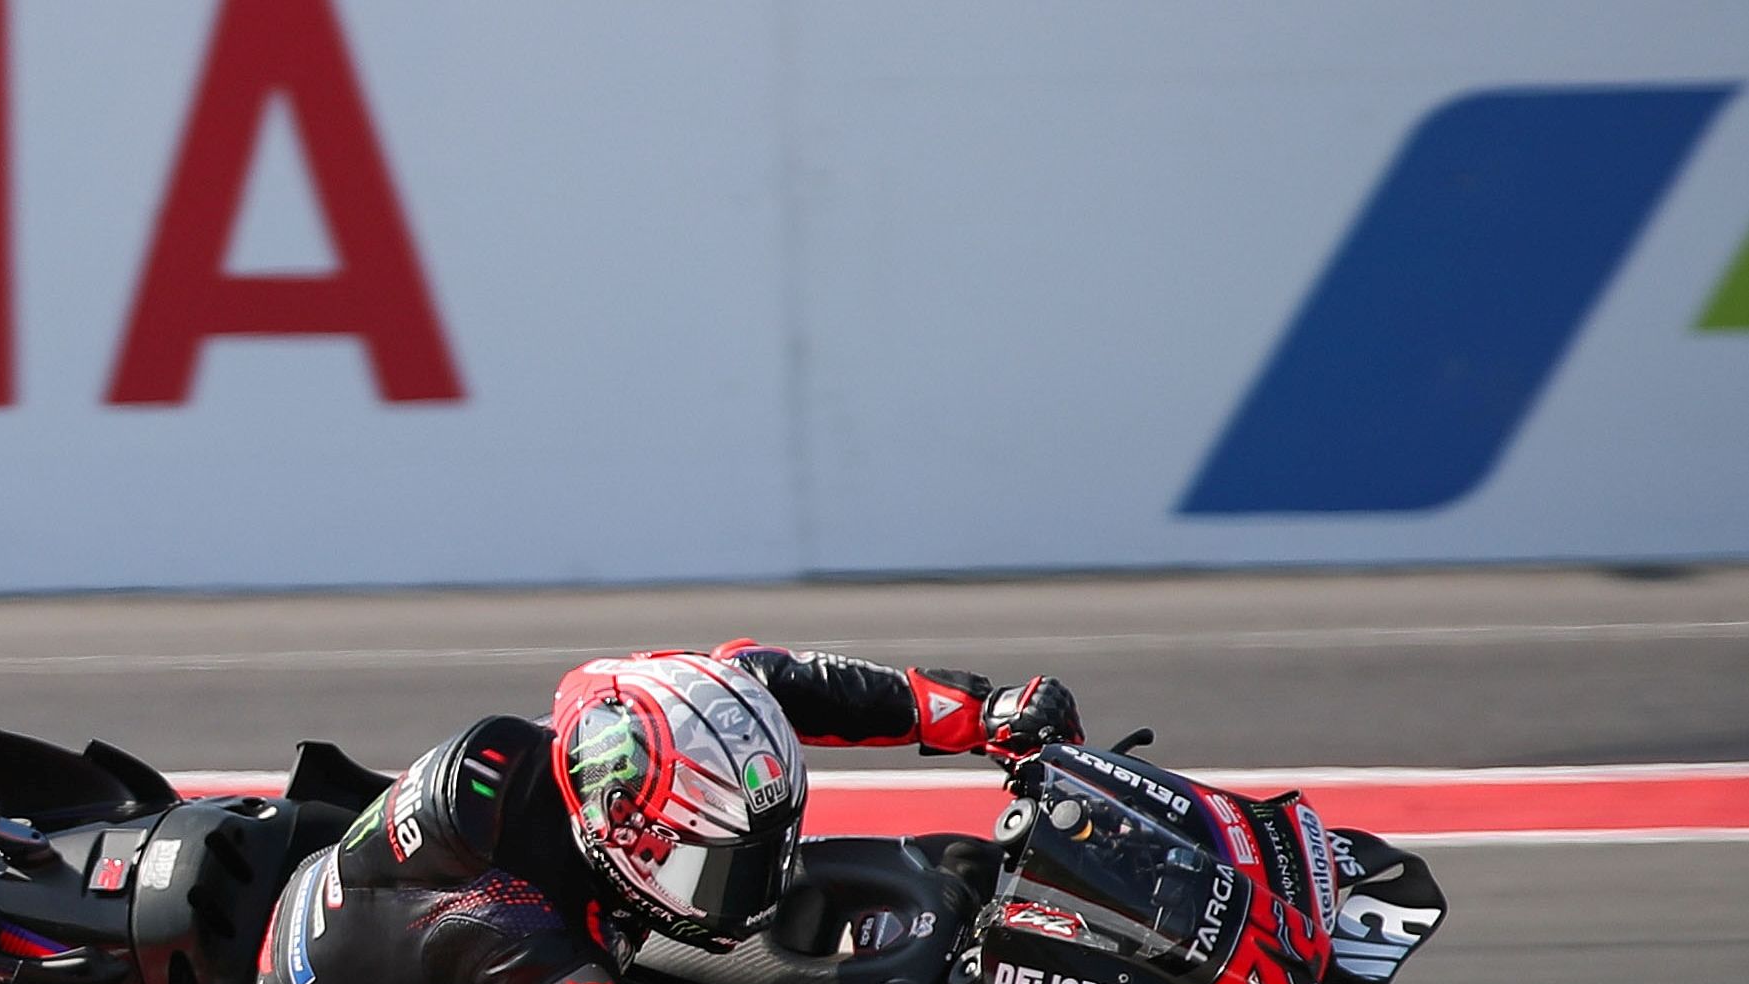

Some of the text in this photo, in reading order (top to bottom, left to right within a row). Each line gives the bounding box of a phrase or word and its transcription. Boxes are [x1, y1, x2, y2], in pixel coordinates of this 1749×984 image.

[717, 707, 745, 729] 72
[755, 780, 785, 807] agv
[1061, 745, 1191, 816] DELLORTO
[1205, 793, 1255, 865] BS
